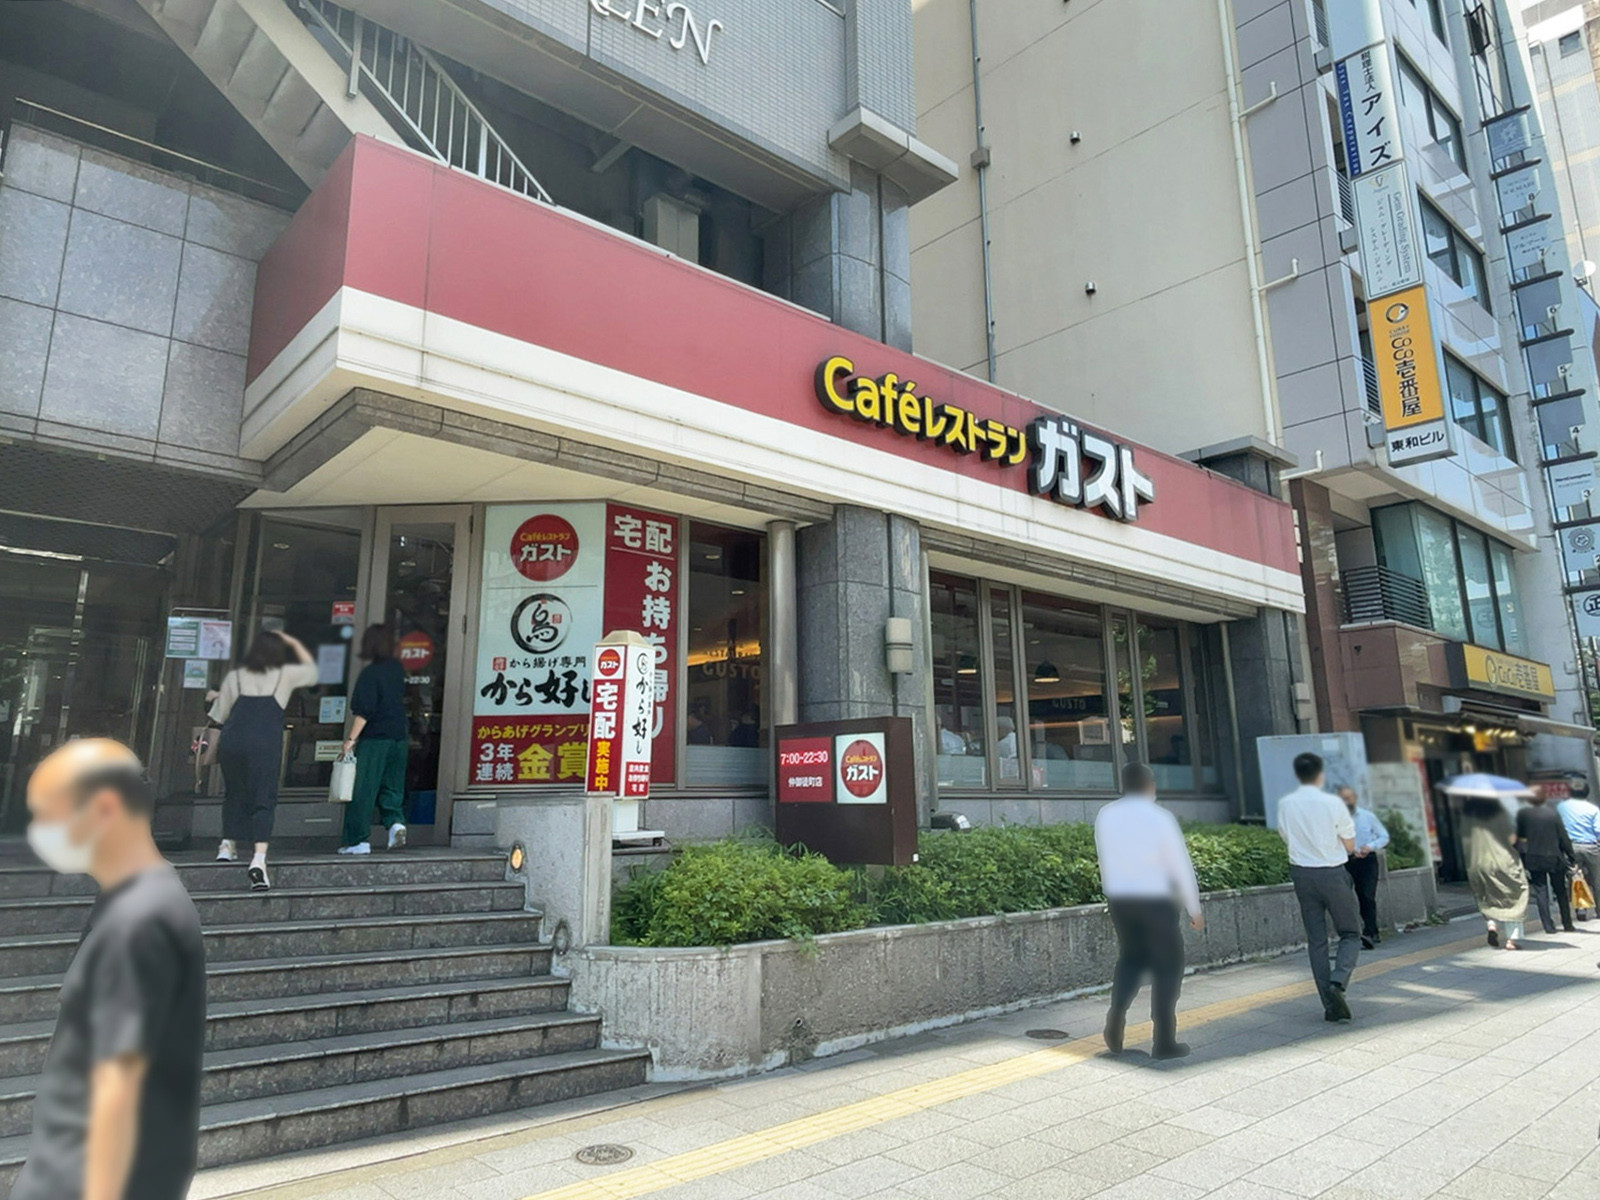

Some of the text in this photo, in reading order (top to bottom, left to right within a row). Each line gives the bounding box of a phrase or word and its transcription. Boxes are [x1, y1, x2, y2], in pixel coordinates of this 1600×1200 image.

[1361, 91, 1392, 167] アイズ
[1540, 249, 1546, 257] 7
[1560, 365, 1568, 374] 5
[1573, 426, 1579, 434] 4
[1391, 431, 1445, 452] 東和ビル
[1035, 416, 1155, 520] ガスト
[1584, 489, 1591, 498] 3
[614, 514, 672, 554] 宅配
[520, 544, 571, 562] ガスト
[509, 655, 587, 669] から揚げ専門
[600, 660, 619, 670] ガスト
[481, 669, 591, 708] から好し
[593, 682, 619, 740] 宅配
[632, 676, 649, 755] から好し
[480, 742, 514, 761] 3年
[517, 742, 588, 780] 金賞
[780, 750, 829, 765] 7:00-22:30
[476, 762, 514, 781] 連続
[594, 741, 611, 792] 実施中
[846, 764, 879, 781] ガスト
